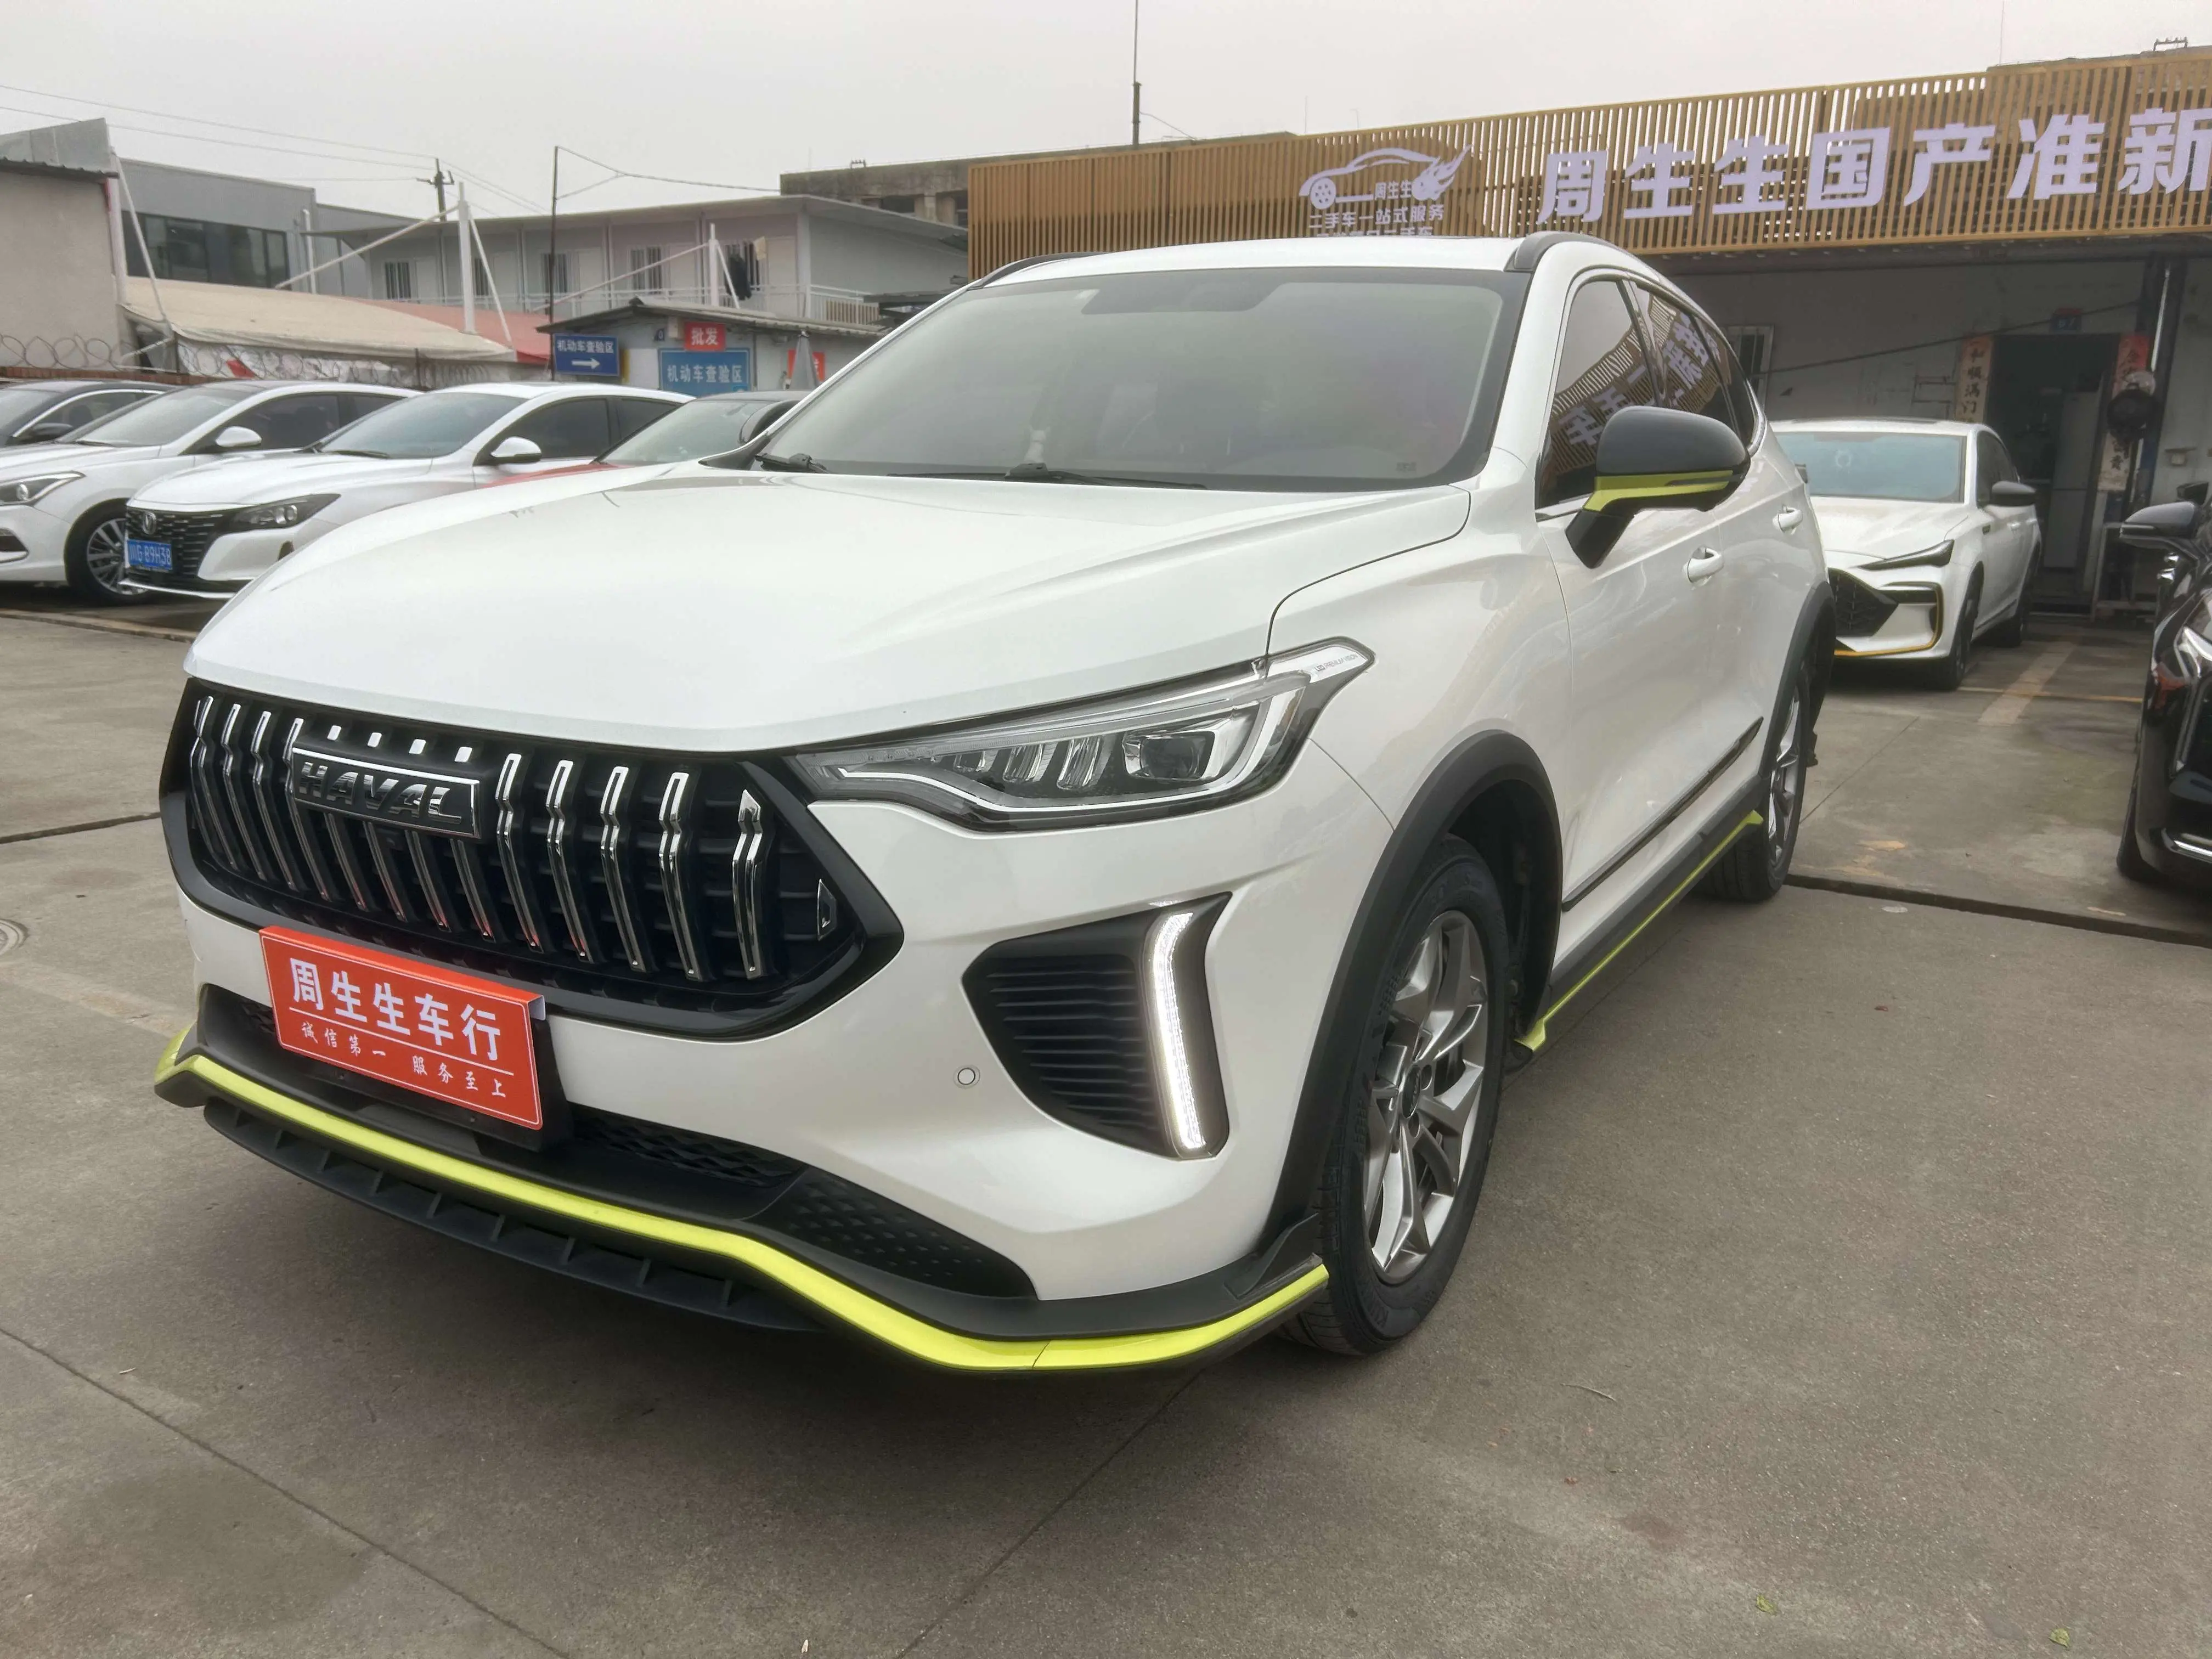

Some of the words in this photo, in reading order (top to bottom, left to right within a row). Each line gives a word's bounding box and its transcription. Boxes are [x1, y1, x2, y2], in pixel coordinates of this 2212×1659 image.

[1537, 108, 2212, 224] 周生生国产准新
[1375, 180, 1412, 200] 周生生
[1308, 204, 1444, 229] 二手车一站式服务
[556, 339, 614, 354] 机动车查验区
[691, 328, 719, 346] 批发
[667, 364, 743, 383] 机动车查验区
[298, 761, 462, 825] HAVAL
[289, 957, 500, 1062] 周生生车行
[301, 1020, 387, 1058] 诚信第一
[412, 1055, 507, 1098] 服务至上
